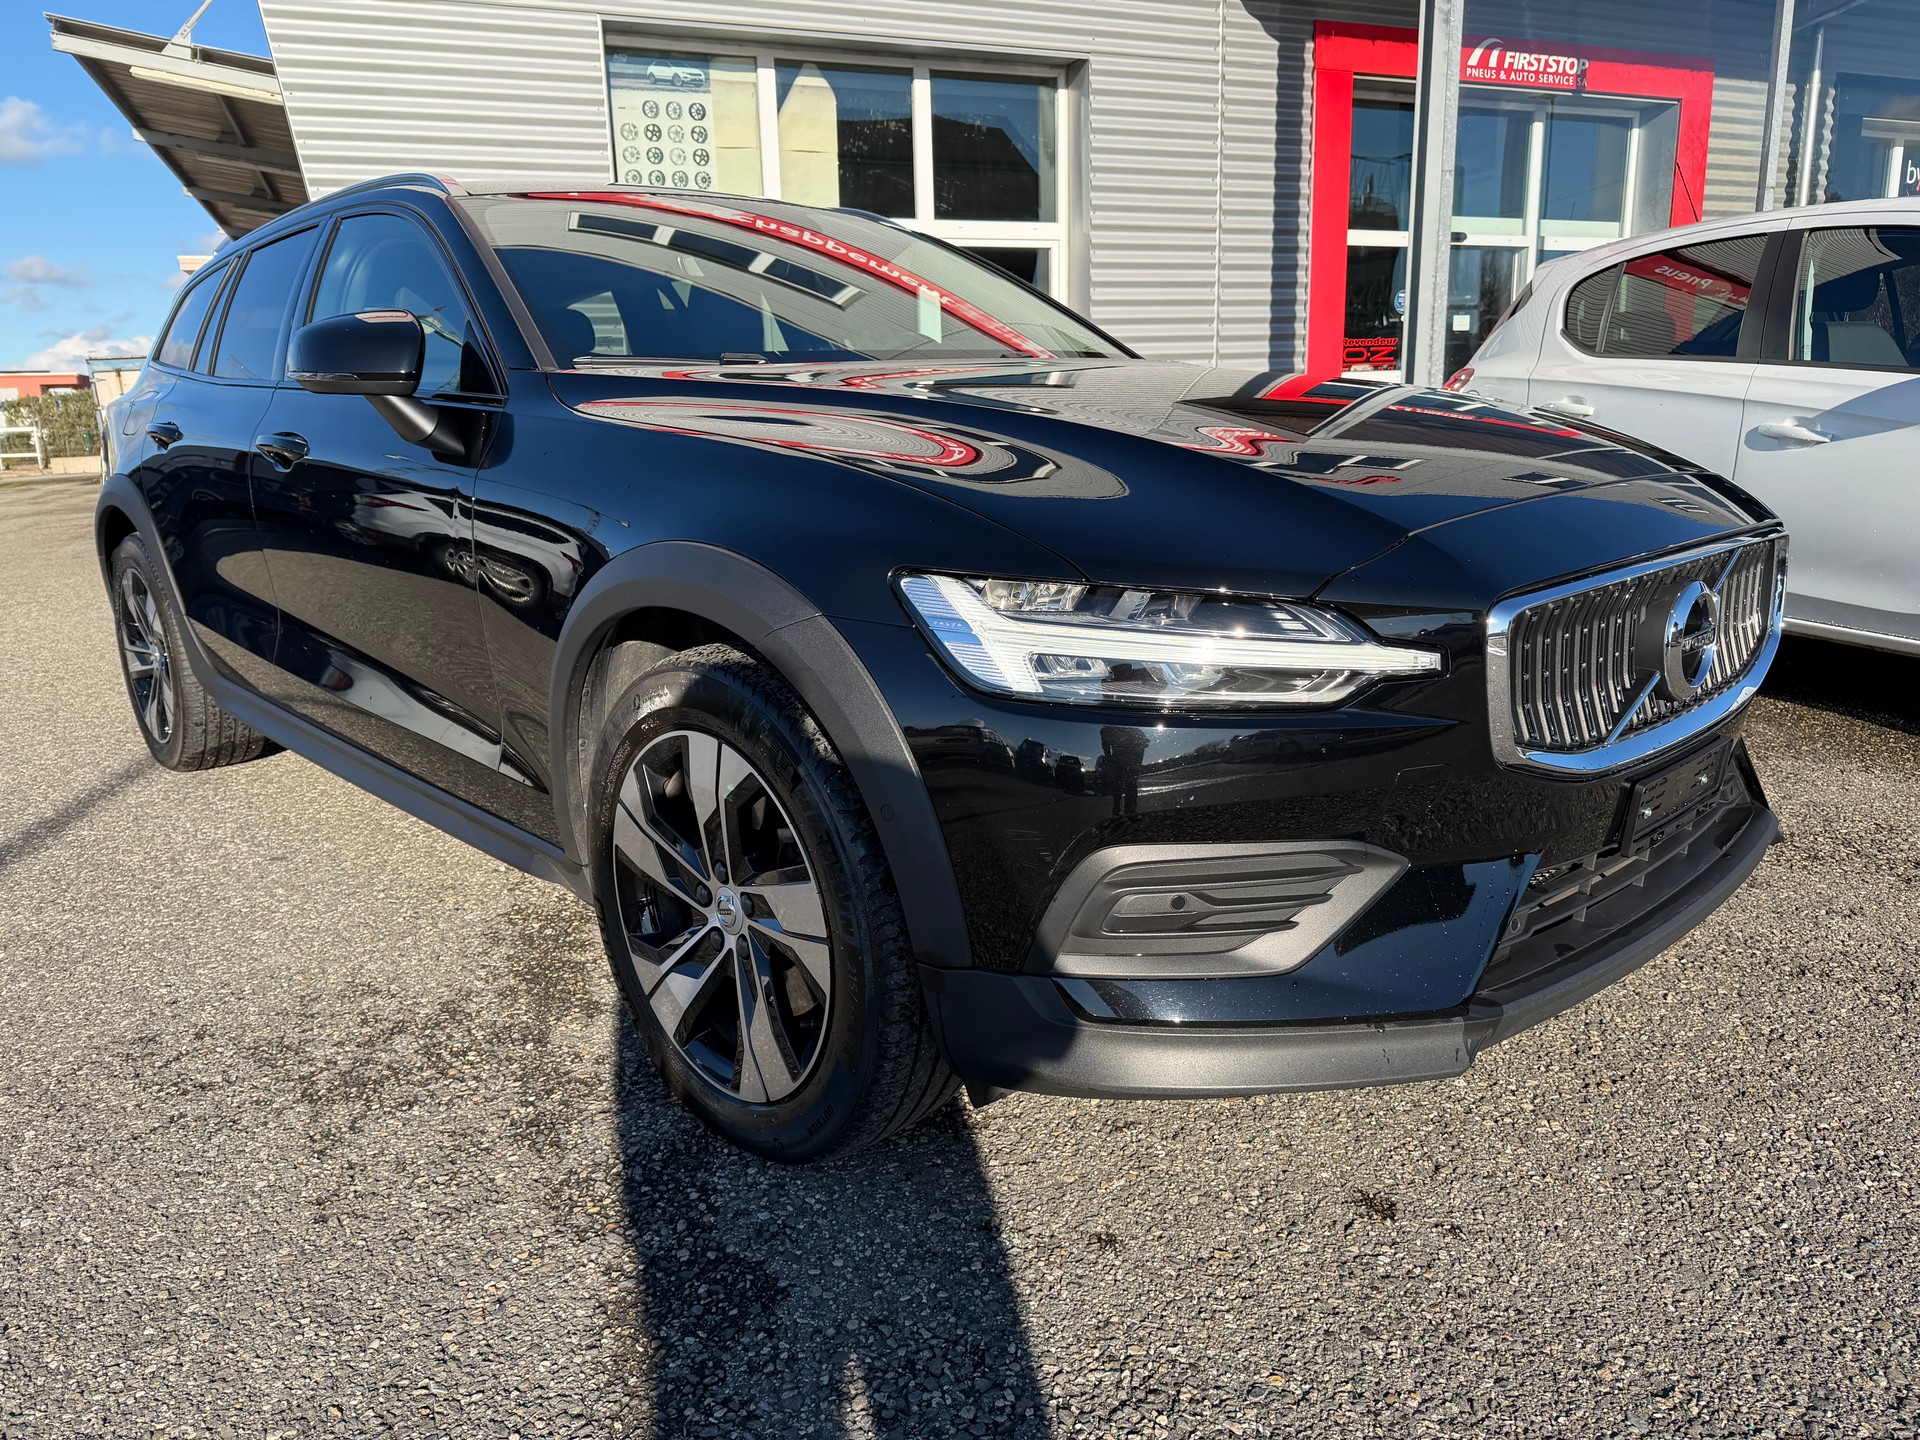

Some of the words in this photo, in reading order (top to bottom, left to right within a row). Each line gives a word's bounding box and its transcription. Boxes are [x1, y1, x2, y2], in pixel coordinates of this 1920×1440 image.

[1466, 67, 1497, 79] PNEUS
[1499, 70, 1507, 80] &
[1509, 71, 1536, 83] AUTO
[1538, 73, 1574, 86] SERVICE
[1576, 77, 1588, 87] SA
[806, 1104, 834, 1137] OUTSIDE
